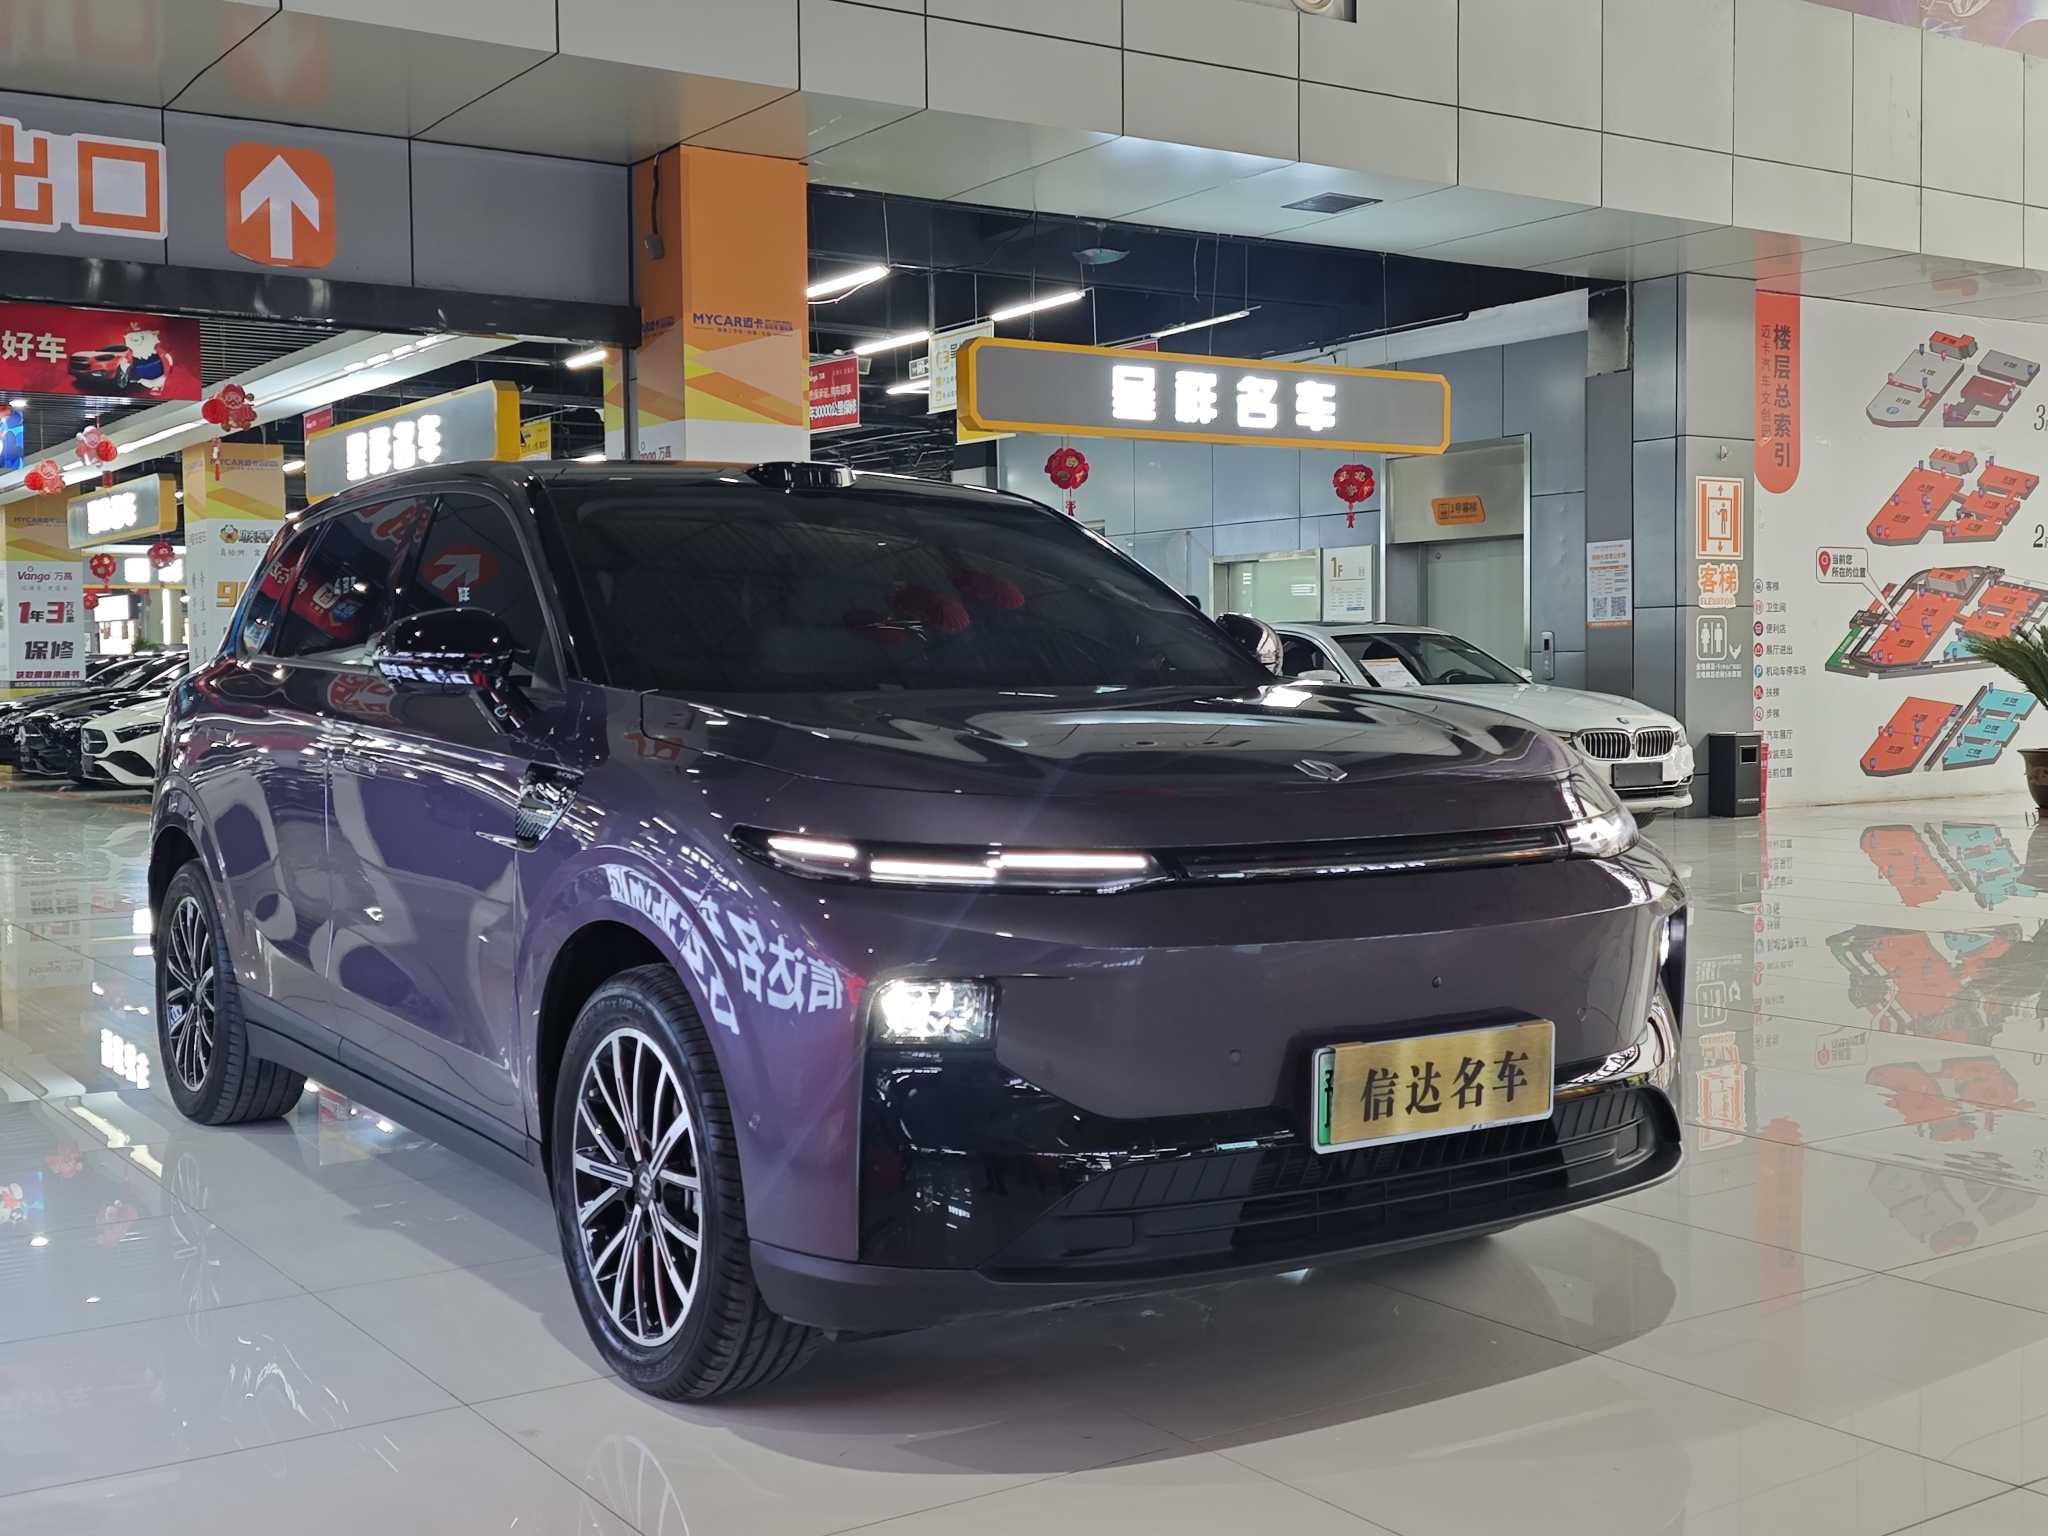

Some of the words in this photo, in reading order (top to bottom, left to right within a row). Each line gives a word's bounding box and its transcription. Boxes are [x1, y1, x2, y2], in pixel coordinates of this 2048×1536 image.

[1, 330, 67, 364] 好车
[1773, 324, 1791, 468] 楼层总索引
[1832, 554, 1853, 565] 当前您
[17, 568, 50, 582] Vango
[1831, 567, 1866, 578] 所在的位置
[1700, 566, 1737, 594] 客梯
[1765, 581, 1779, 592] 客梯
[1766, 602, 1787, 612] 卫生间
[1766, 623, 1787, 634] 便利店
[25, 641, 74, 659] 保修
[1766, 665, 1807, 676] 机动车停车场
[1361, 1050, 1529, 1122] 信达名车
